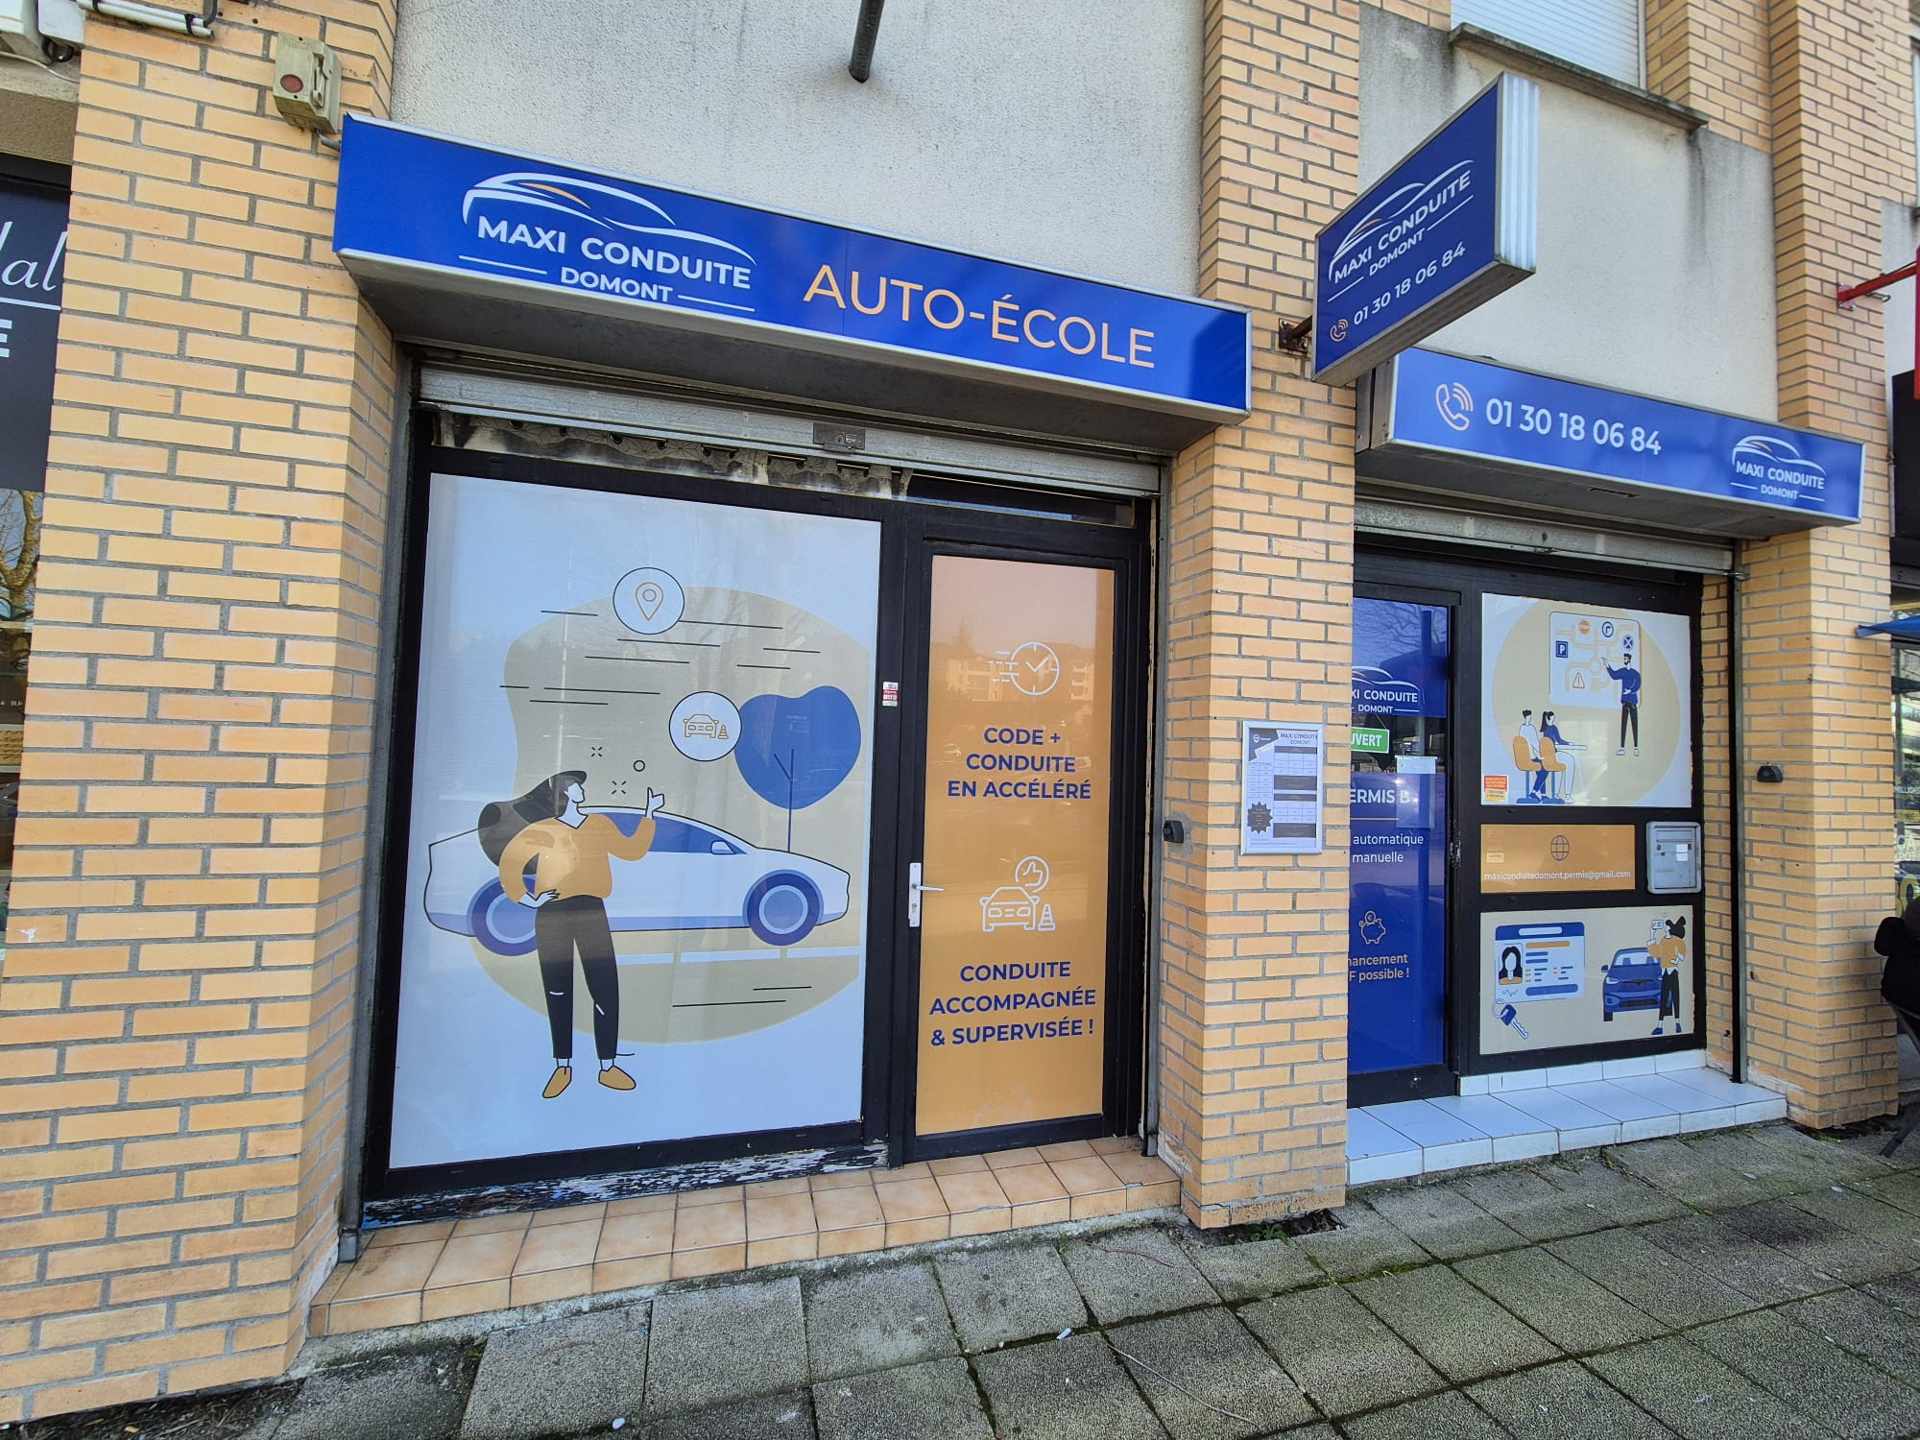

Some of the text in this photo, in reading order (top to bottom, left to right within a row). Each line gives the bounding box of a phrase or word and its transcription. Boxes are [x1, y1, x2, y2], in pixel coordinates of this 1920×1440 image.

[1335, 170, 1471, 284] MAXI CONDUITE
[478, 215, 751, 289] MAXI CONDUITE
[1369, 228, 1425, 276] DOMONT
[560, 266, 673, 302] DOMONT
[1354, 241, 1466, 325] 01 30 18 06 84
[803, 264, 1155, 368] AUTO-ÉCOLE
[1486, 398, 1662, 455] 01 30 18 06 84
[1736, 461, 1825, 489] MAXI CONDUITE
[1761, 484, 1798, 499] DOMONT
[1364, 689, 1418, 703] CONDUITE
[1358, 704, 1393, 713] DOMONT
[984, 727, 1044, 745] CODE
[966, 754, 1076, 773] CONDUITE
[948, 779, 1091, 799] EN ACCÉLÉRÉ
[1350, 789, 1395, 804] ERMIS
[1353, 833, 1424, 847] automatique
[1352, 851, 1404, 863] manuelle
[960, 961, 1071, 982] CONDUITE
[1358, 967, 1404, 984] possible
[929, 986, 1097, 1015] ACCOMPAGNÉE
[930, 1029, 945, 1046] &
[952, 1016, 1083, 1045] SUPERVISÉE
